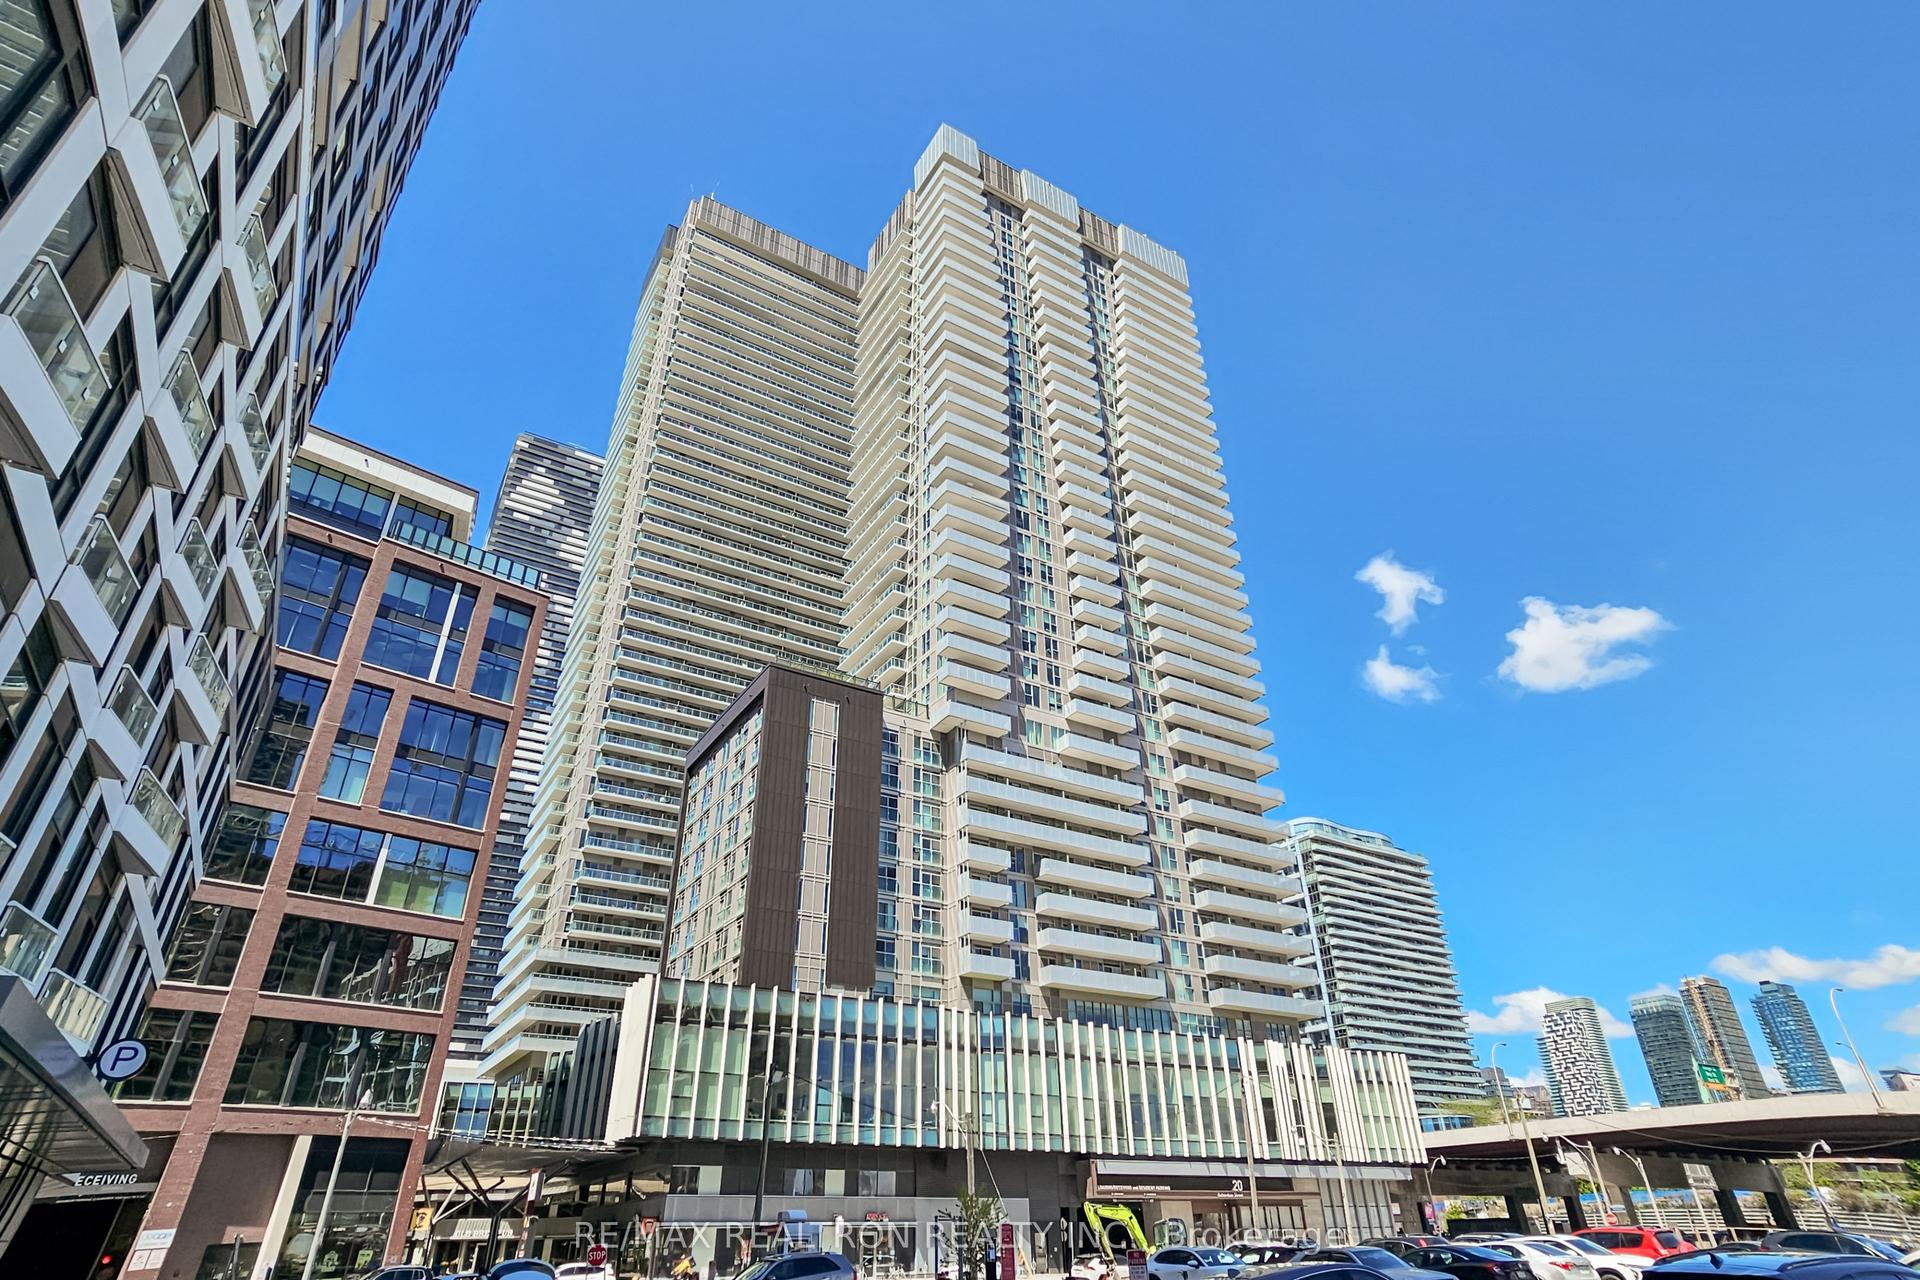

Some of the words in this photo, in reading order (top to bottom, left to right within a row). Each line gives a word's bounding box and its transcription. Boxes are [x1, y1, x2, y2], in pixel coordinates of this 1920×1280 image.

[109, 1046, 139, 1072] P
[74, 1173, 138, 1187] ECEIVING
[1231, 1179, 1244, 1192] 20
[588, 1250, 605, 1261] STOP
